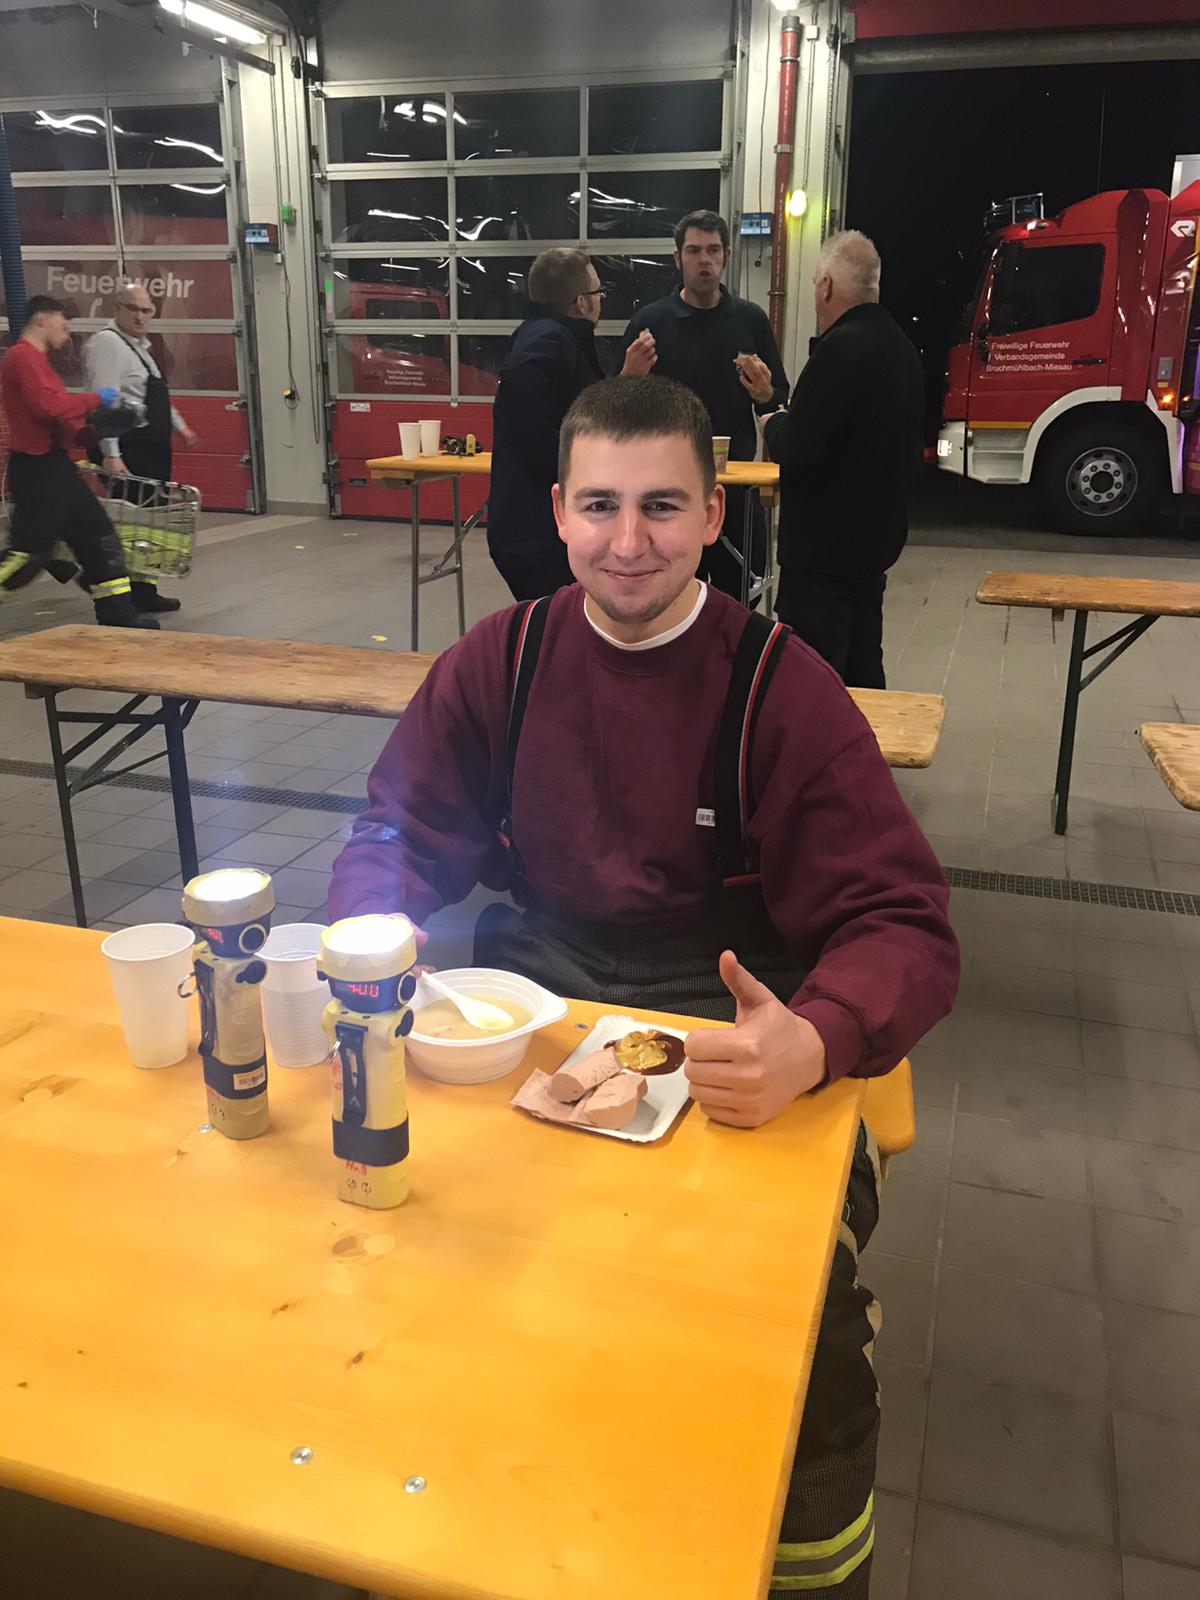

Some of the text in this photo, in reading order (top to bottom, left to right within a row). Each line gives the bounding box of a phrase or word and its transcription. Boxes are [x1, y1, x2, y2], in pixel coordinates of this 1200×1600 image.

[47, 266, 194, 298] Feuerwehr
[991, 341, 1070, 351] Freiwillige Feuerwehr
[994, 352, 1065, 361] Verbandsgemeinde
[986, 363, 1072, 372] Bruchmühlbach-Miesau
